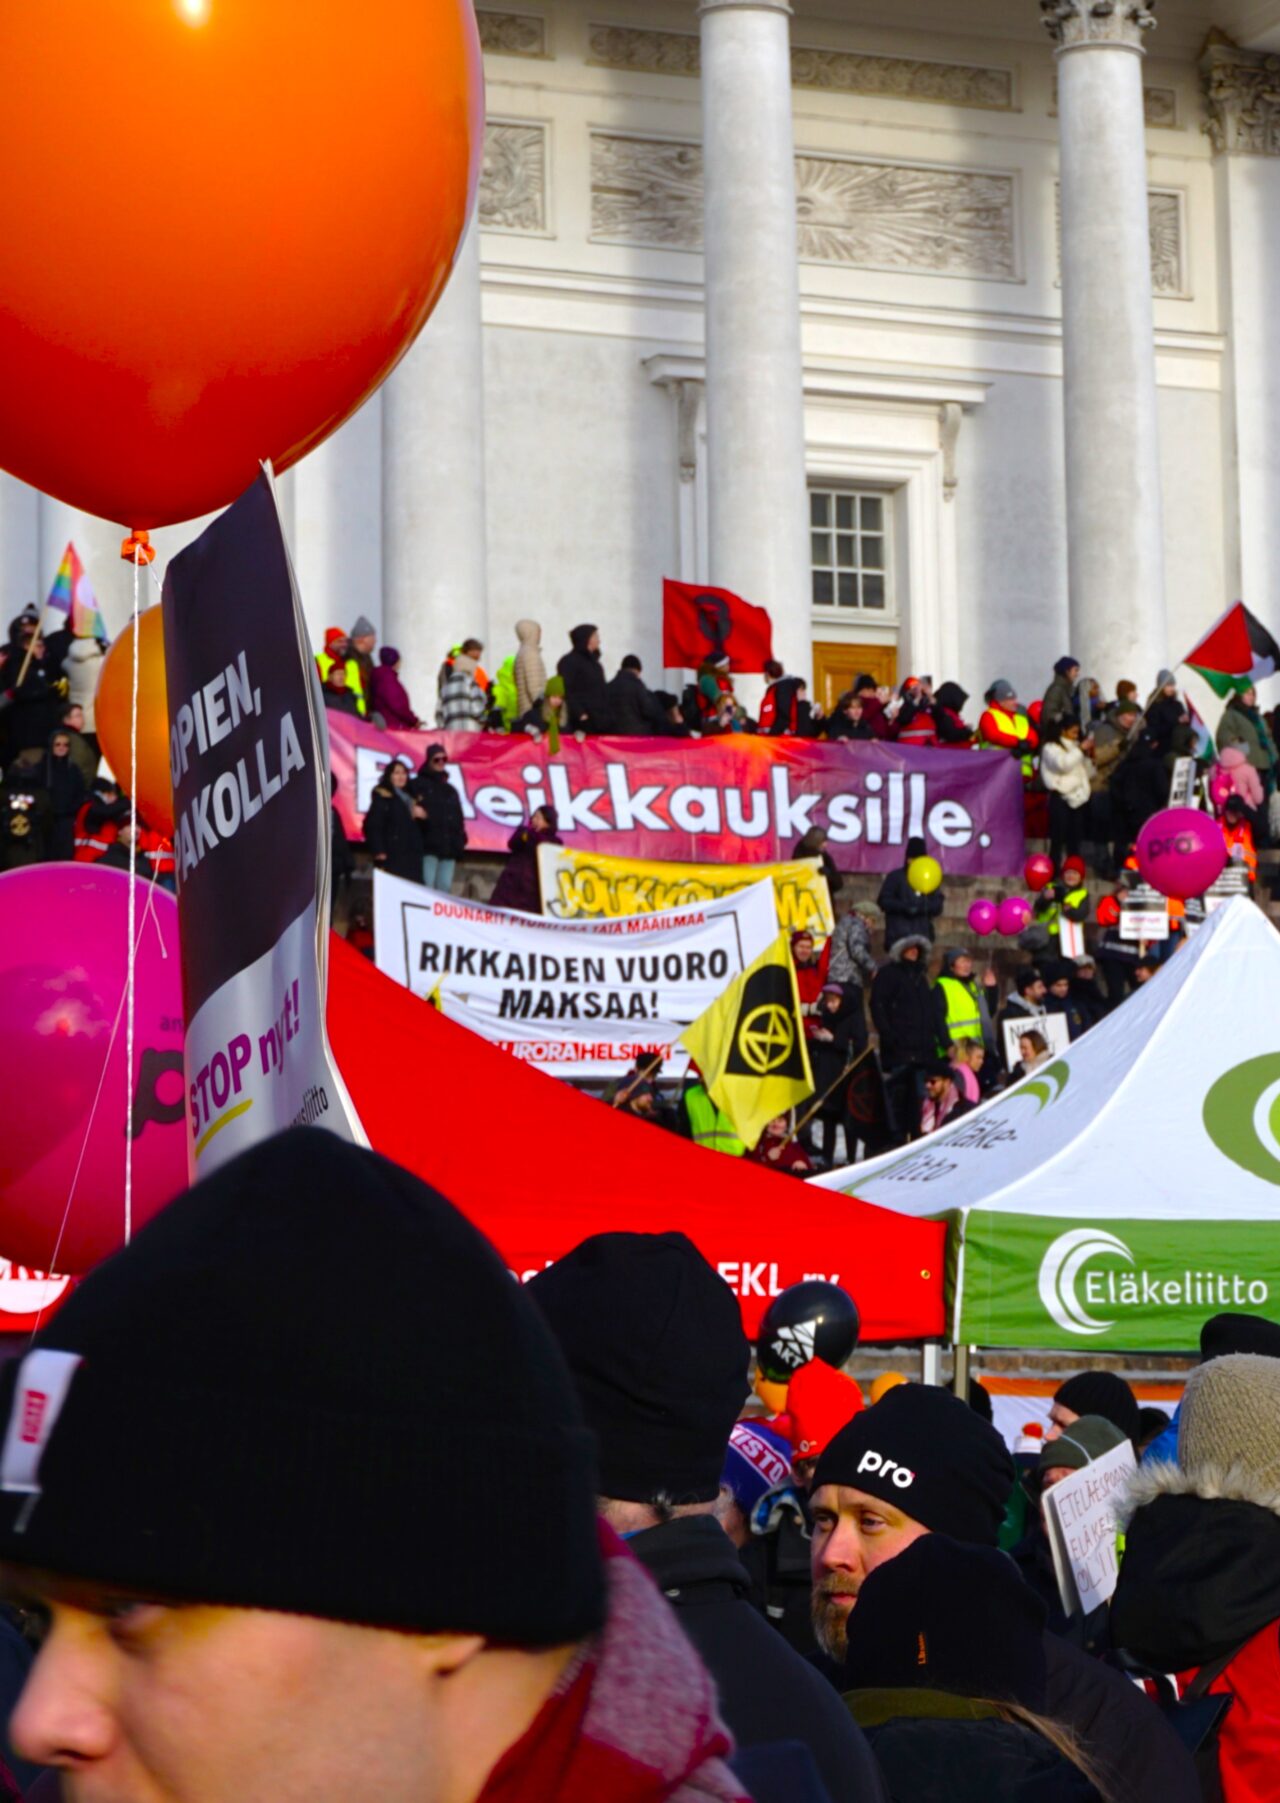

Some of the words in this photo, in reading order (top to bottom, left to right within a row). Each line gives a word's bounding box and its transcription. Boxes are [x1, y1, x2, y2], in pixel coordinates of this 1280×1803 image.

[627, 912, 705, 934] MAAILMAA
[419, 941, 606, 984] RIKKAIDEN
[616, 949, 729, 983] VUORO
[499, 988, 659, 1020] MAKSAA!
[189, 1034, 252, 1140] STOP
[259, 979, 300, 1076] nyt!
[717, 1261, 785, 1298] EKL
[1085, 1270, 1269, 1306] Eläkeliitto
[857, 1450, 916, 1489] pro
